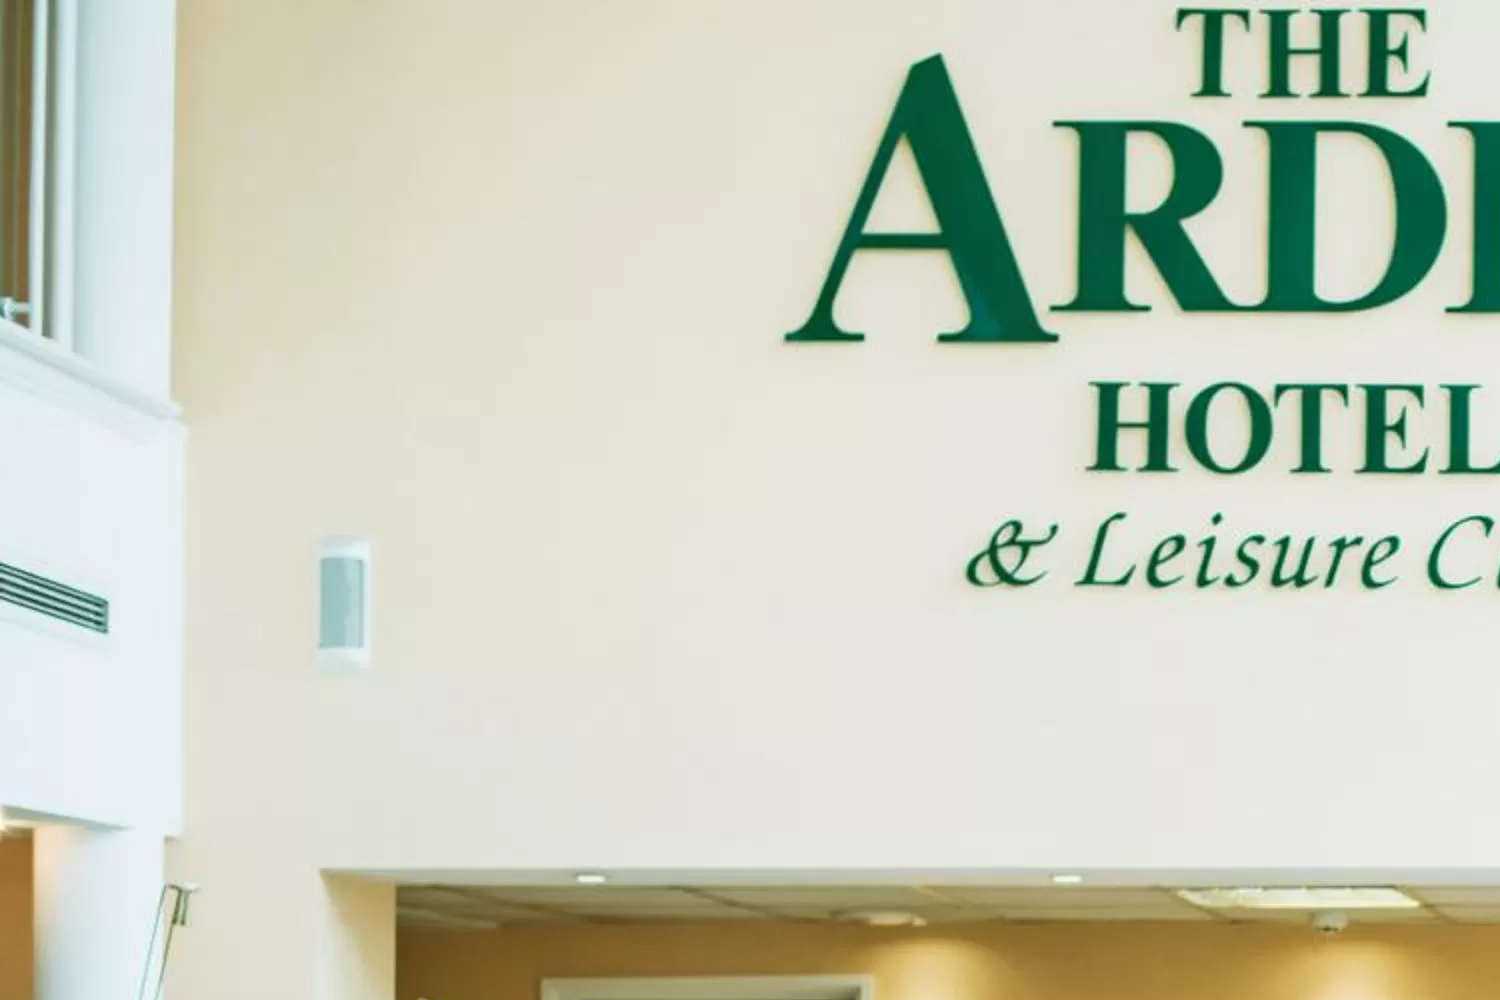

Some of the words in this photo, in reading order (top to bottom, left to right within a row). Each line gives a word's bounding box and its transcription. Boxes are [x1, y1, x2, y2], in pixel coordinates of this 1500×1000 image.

[1175, 7, 1431, 98] THE
[965, 519, 1059, 588] &
[1075, 511, 1401, 590] Leisure
